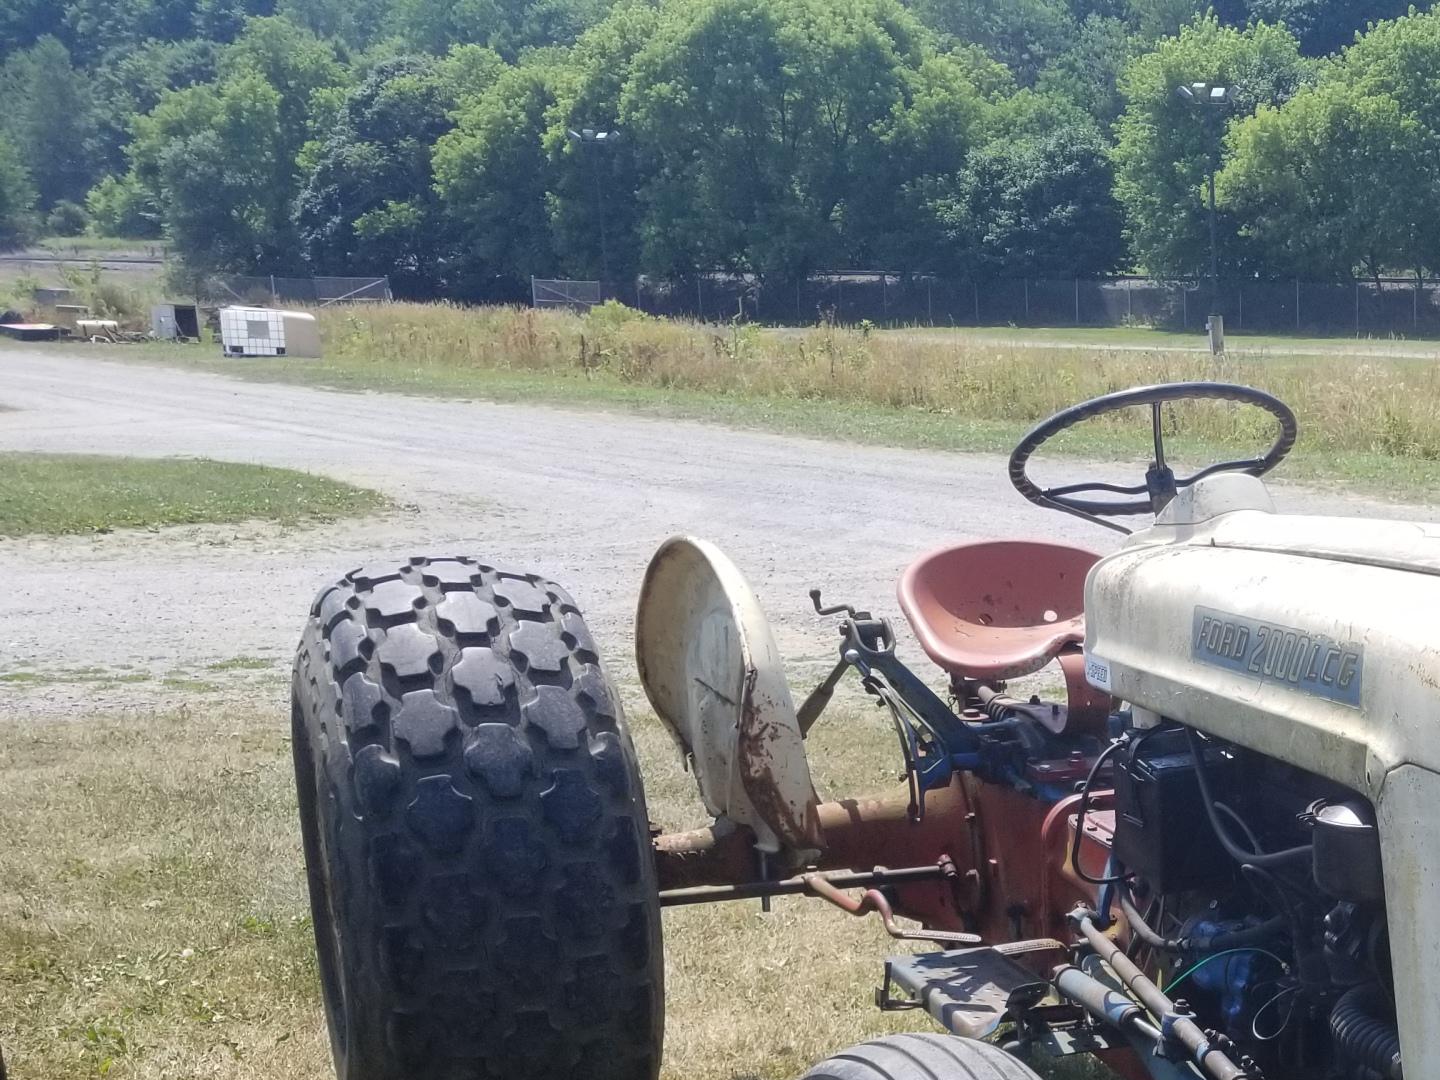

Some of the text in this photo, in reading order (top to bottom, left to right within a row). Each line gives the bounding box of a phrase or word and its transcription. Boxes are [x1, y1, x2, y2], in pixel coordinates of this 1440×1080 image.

[1195, 616, 1358, 688] FORD 2000 LCG
